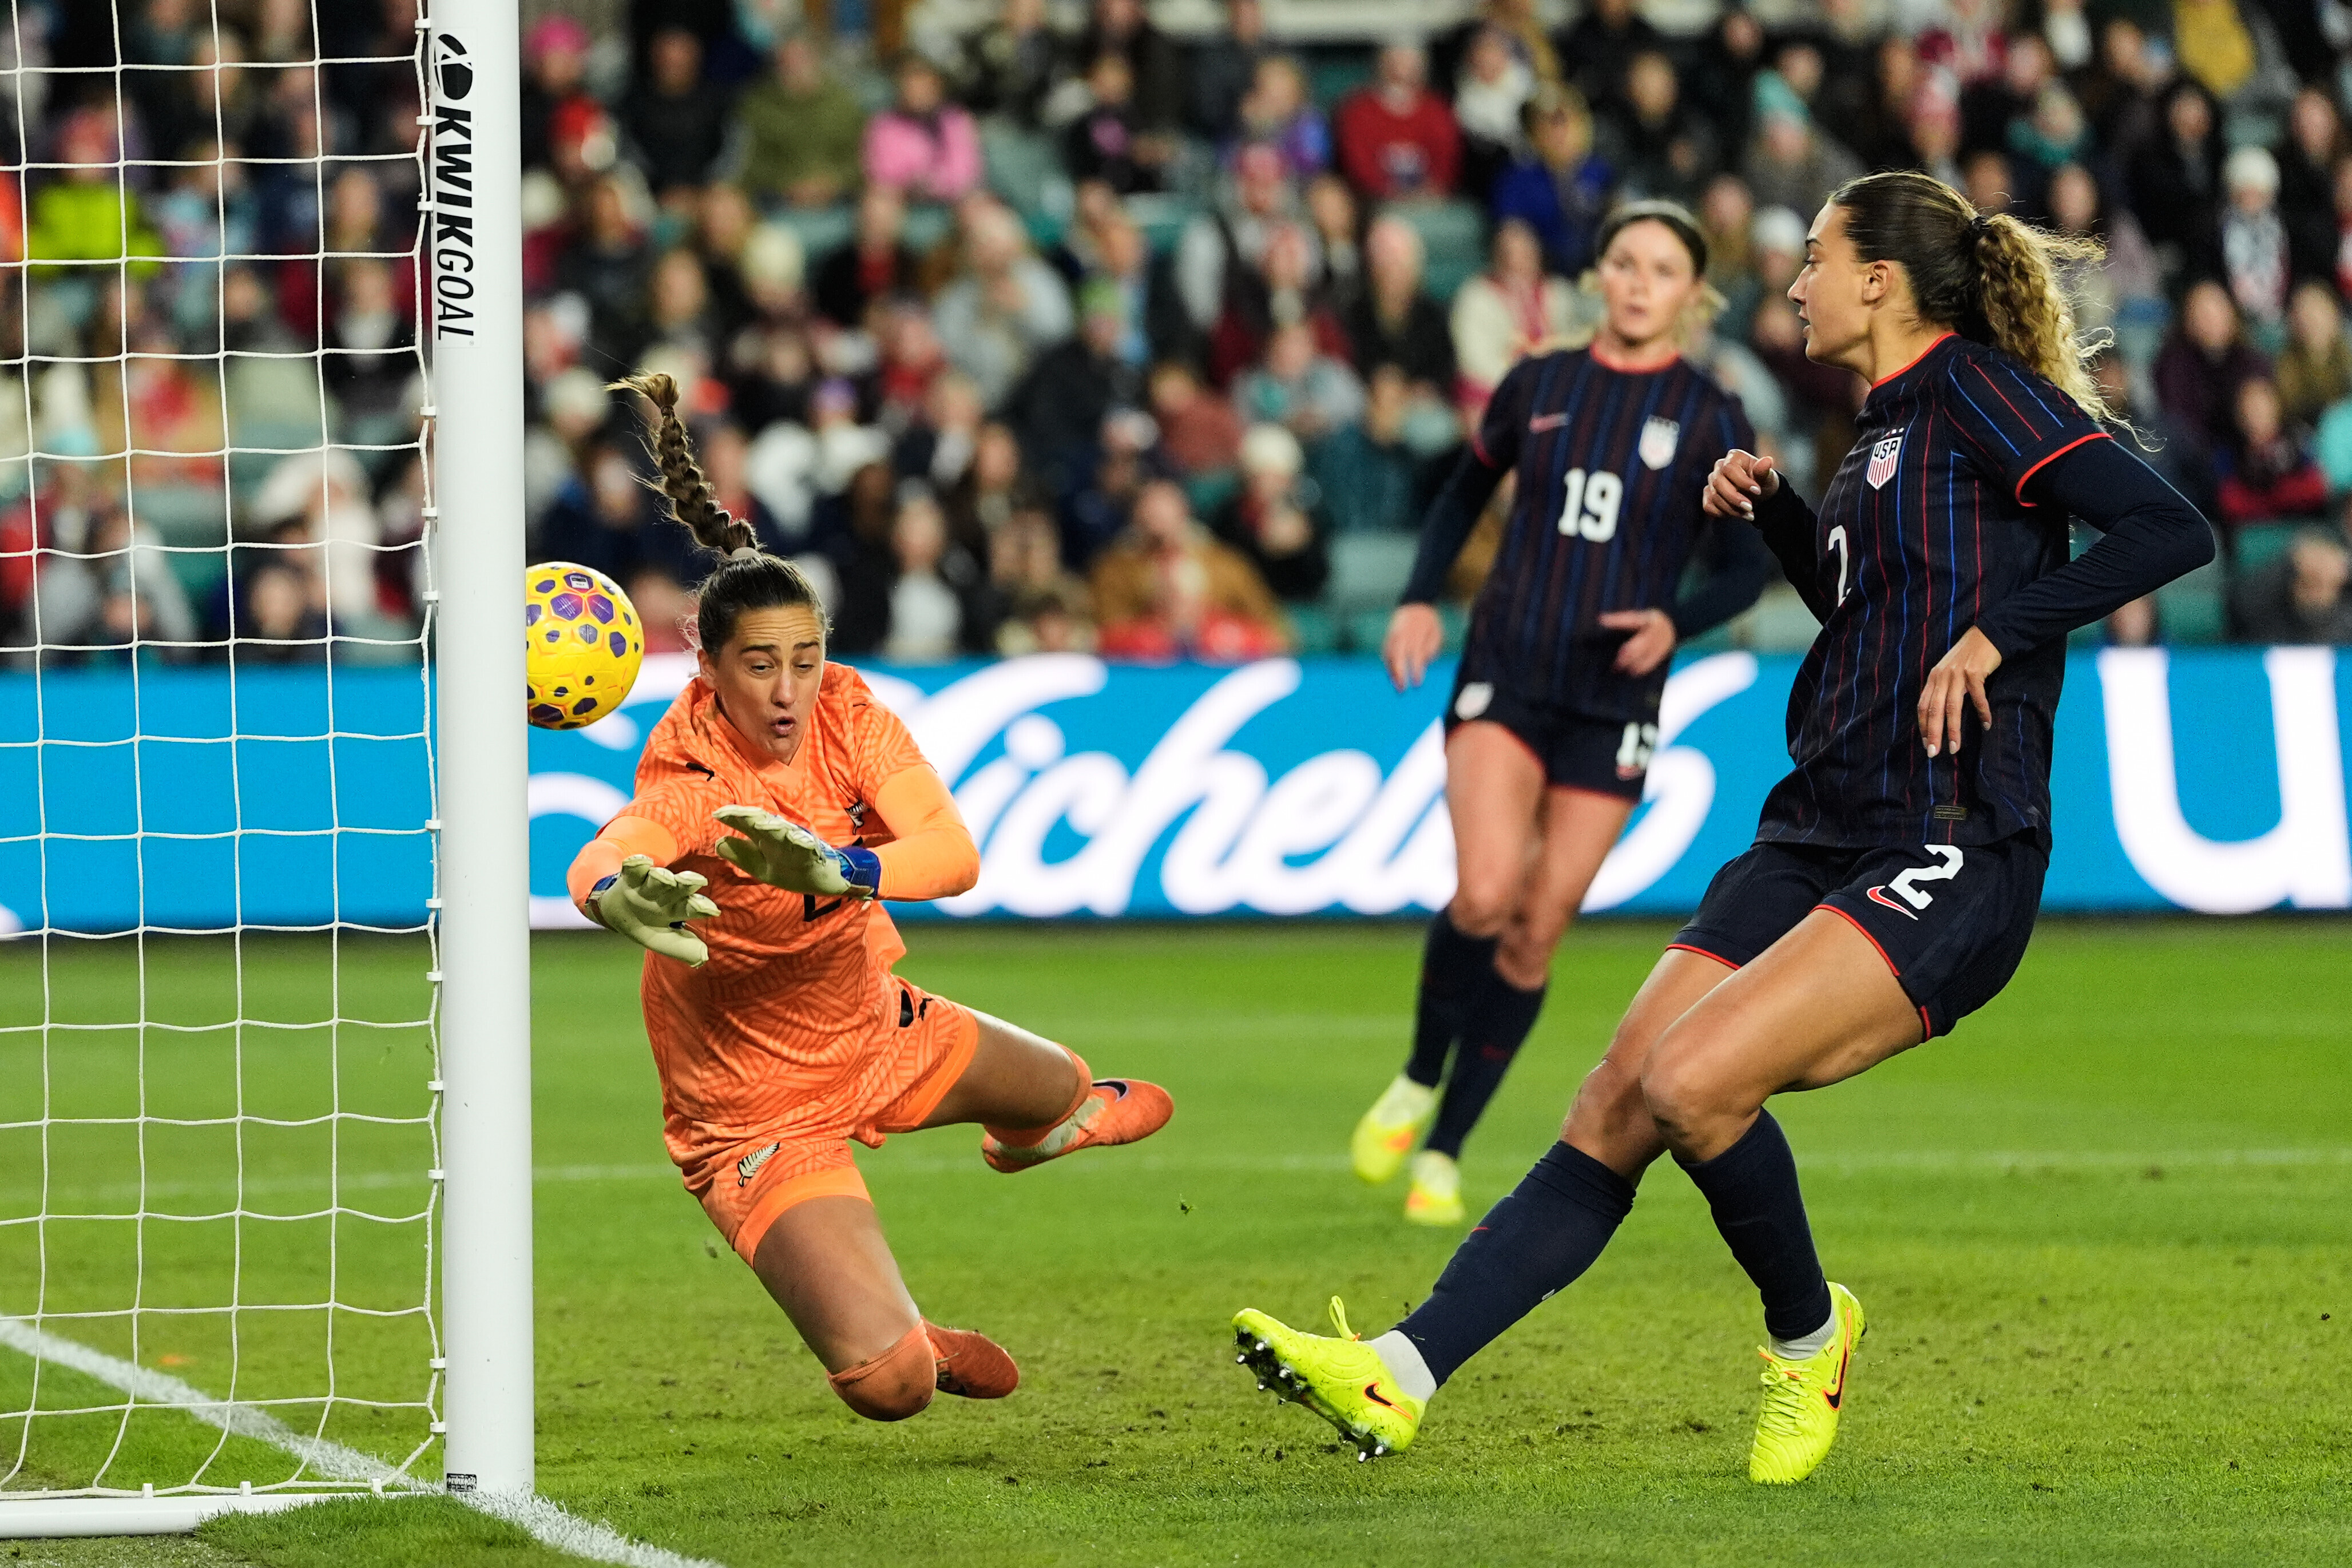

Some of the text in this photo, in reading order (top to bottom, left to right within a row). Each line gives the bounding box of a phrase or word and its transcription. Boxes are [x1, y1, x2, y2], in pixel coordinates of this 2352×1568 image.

[435, 105, 474, 340] KWIKGOAL
[1874, 440, 1898, 459] USA
[1558, 467, 1623, 543] 19
[1889, 844, 1964, 910] 2
